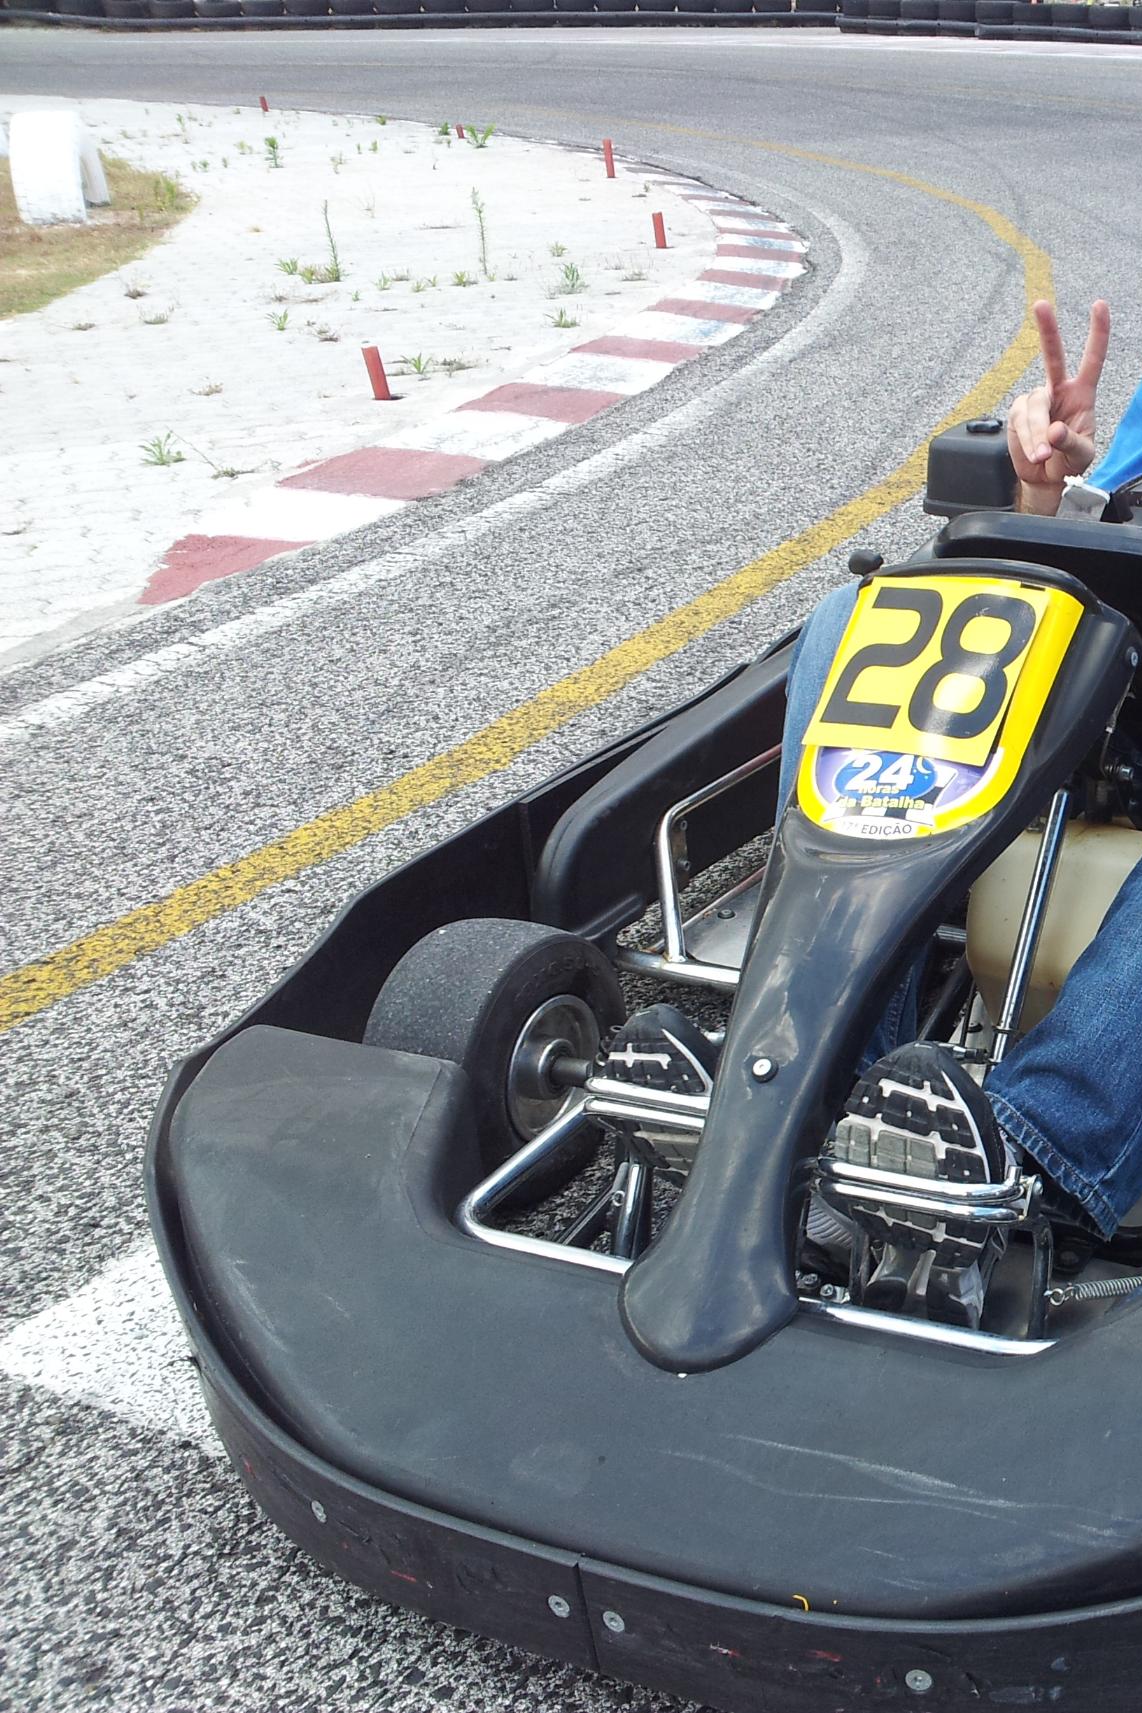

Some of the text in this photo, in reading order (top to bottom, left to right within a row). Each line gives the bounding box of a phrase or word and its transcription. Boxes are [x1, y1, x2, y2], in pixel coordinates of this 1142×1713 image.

[820, 586, 1036, 739] 28
[844, 752, 915, 791] 24
[857, 784, 901, 795] horas
[838, 795, 926, 811] da Batalha
[859, 822, 913, 836] EDIÇÃO
